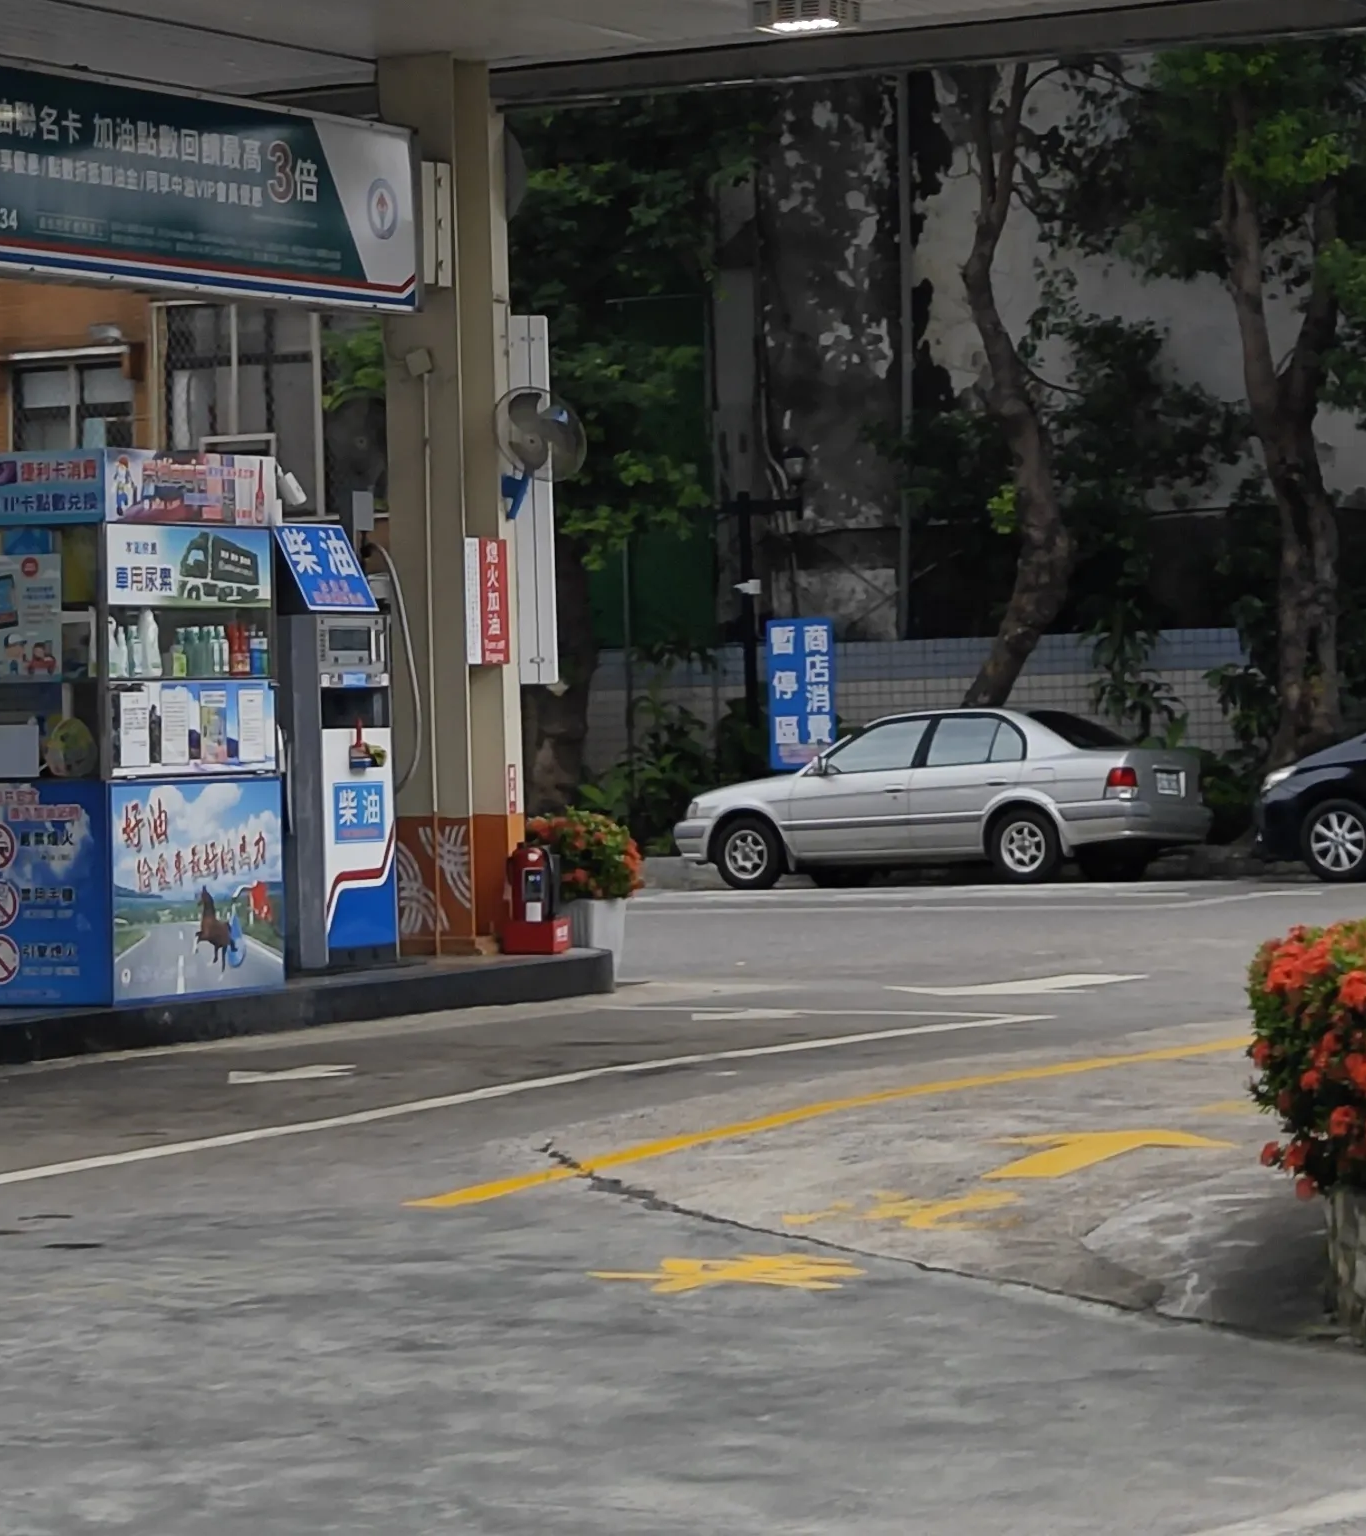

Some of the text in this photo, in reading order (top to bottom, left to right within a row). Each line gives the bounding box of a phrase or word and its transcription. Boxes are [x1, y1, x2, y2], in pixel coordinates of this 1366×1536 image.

[281, 527, 360, 580] 柴油
[485, 540, 501, 635] 熄火加油
[803, 625, 832, 745] 商店消費
[122, 797, 170, 853] 好油
[338, 782, 383, 826] 柴油
